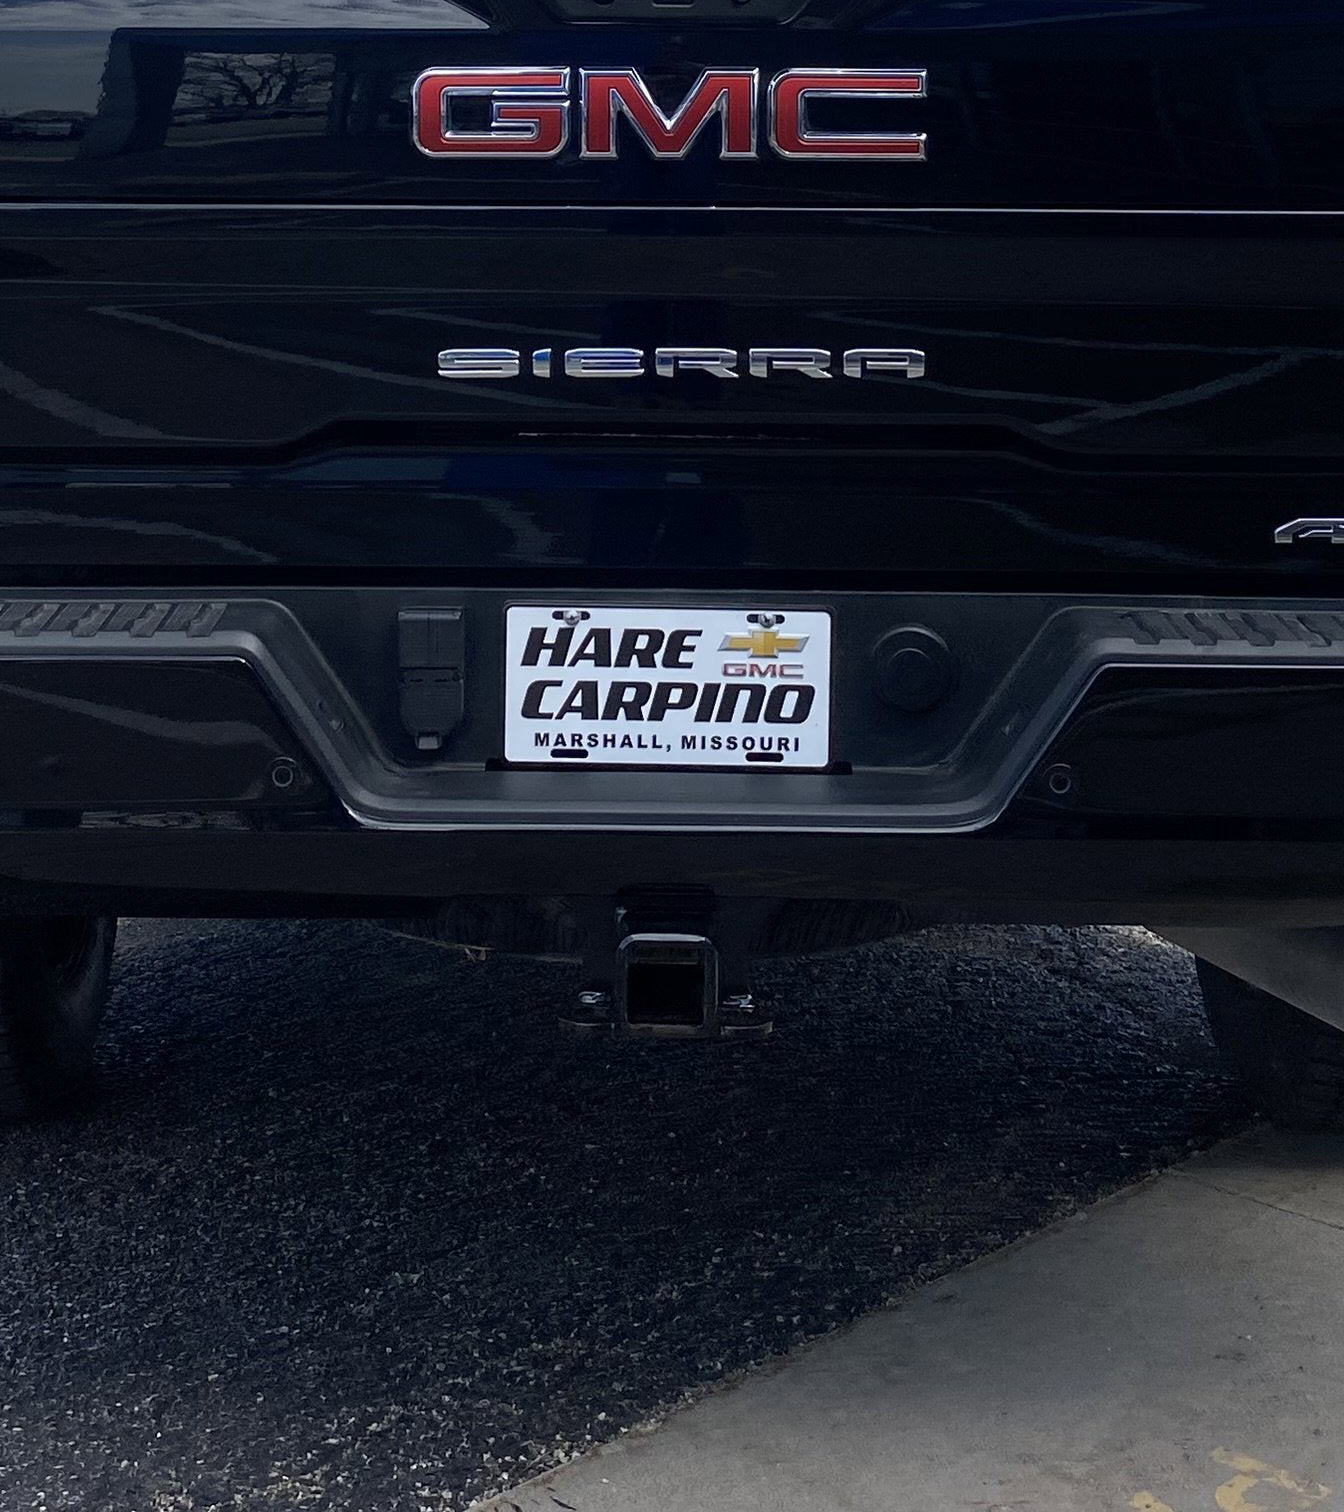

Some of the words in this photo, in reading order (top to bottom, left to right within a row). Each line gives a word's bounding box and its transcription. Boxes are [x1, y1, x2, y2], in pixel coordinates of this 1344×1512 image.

[411, 66, 928, 161] GMC
[437, 347, 926, 379] SIERRA
[520, 626, 703, 669] HARE
[722, 662, 804, 679] GMC
[520, 679, 816, 724] CARPINO
[534, 732, 672, 753] MARSHALL,
[681, 735, 800, 752] MISSOURI
